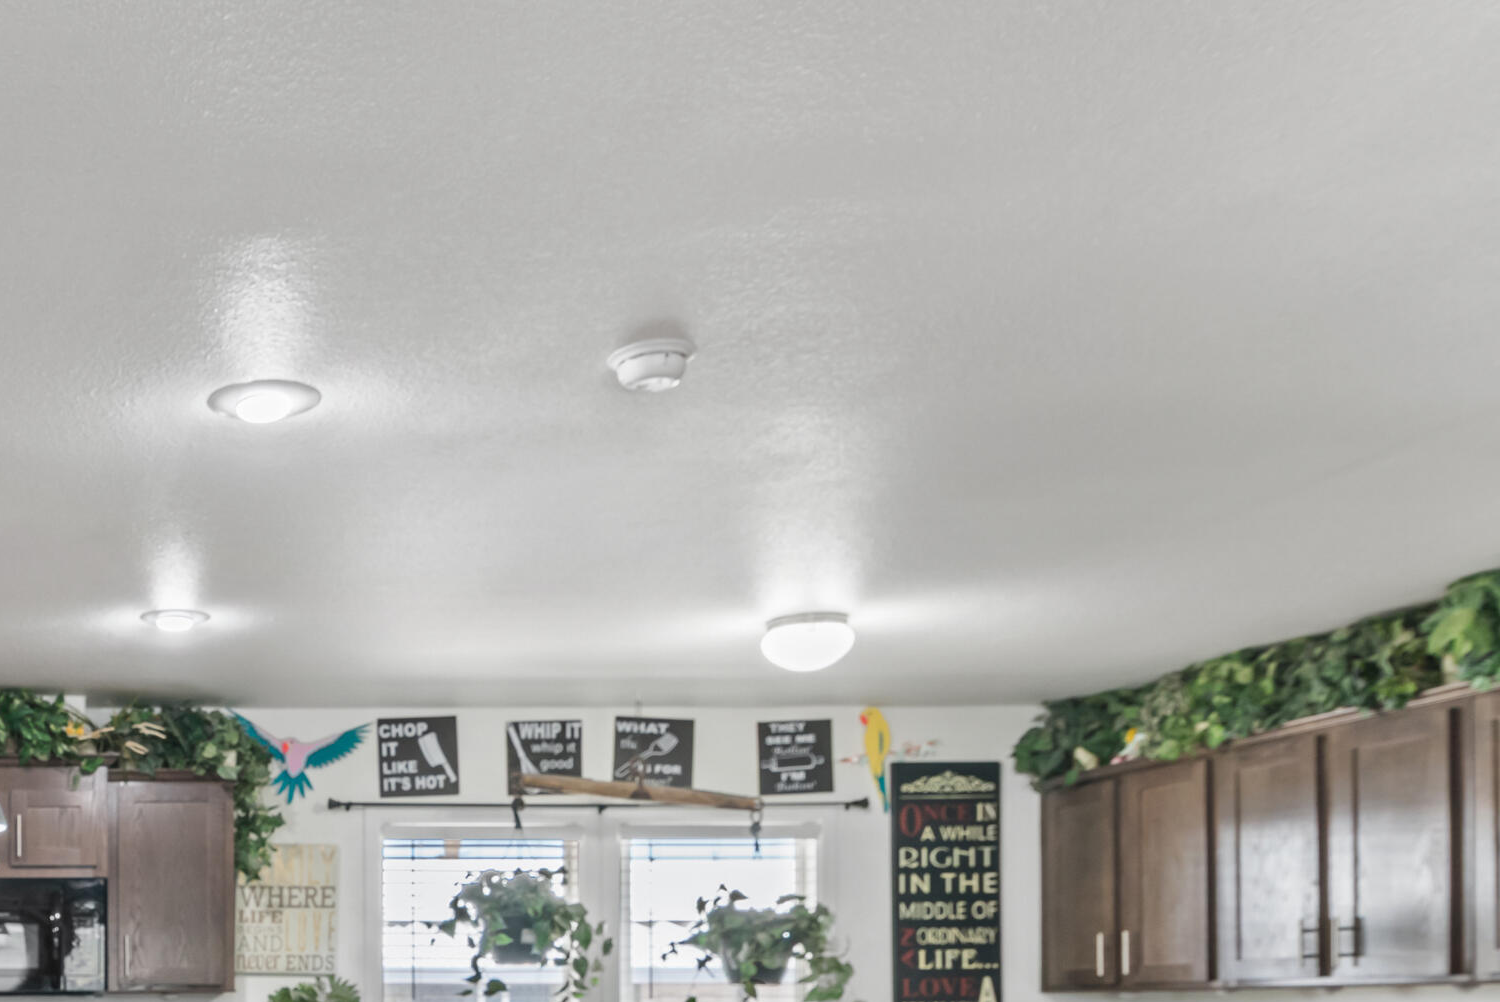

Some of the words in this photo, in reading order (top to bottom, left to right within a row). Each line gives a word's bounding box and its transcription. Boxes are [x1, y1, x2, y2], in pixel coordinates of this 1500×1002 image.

[379, 722, 428, 739] CHOP
[520, 722, 562, 739] WHIP
[566, 722, 581, 739] IT
[616, 721, 669, 735] WHAT
[769, 722, 806, 734] THEY
[795, 733, 817, 744] ME
[381, 742, 399, 757] IT
[531, 742, 563, 755] whip
[566, 742, 576, 753] it
[382, 760, 418, 775] LIKE
[540, 757, 574, 772] good
[654, 763, 682, 775] FOR
[383, 776, 412, 792] IT'S
[414, 774, 446, 790] HOT
[899, 803, 972, 838] ONCE
[976, 801, 997, 822] IN
[921, 825, 936, 842] A
[939, 824, 998, 842] WHILE
[899, 845, 997, 868] RIGHT
[899, 872, 931, 894] IN
[940, 872, 998, 894] THE
[239, 886, 336, 909] WHERE
[238, 911, 283, 924] LIFE
[899, 901, 967, 920] MIDDLE
[971, 900, 998, 920] OF
[238, 936, 283, 952] AND
[916, 926, 998, 946] ORDINARY
[285, 954, 335, 971] ENDS
[902, 978, 978, 998] LOVE
